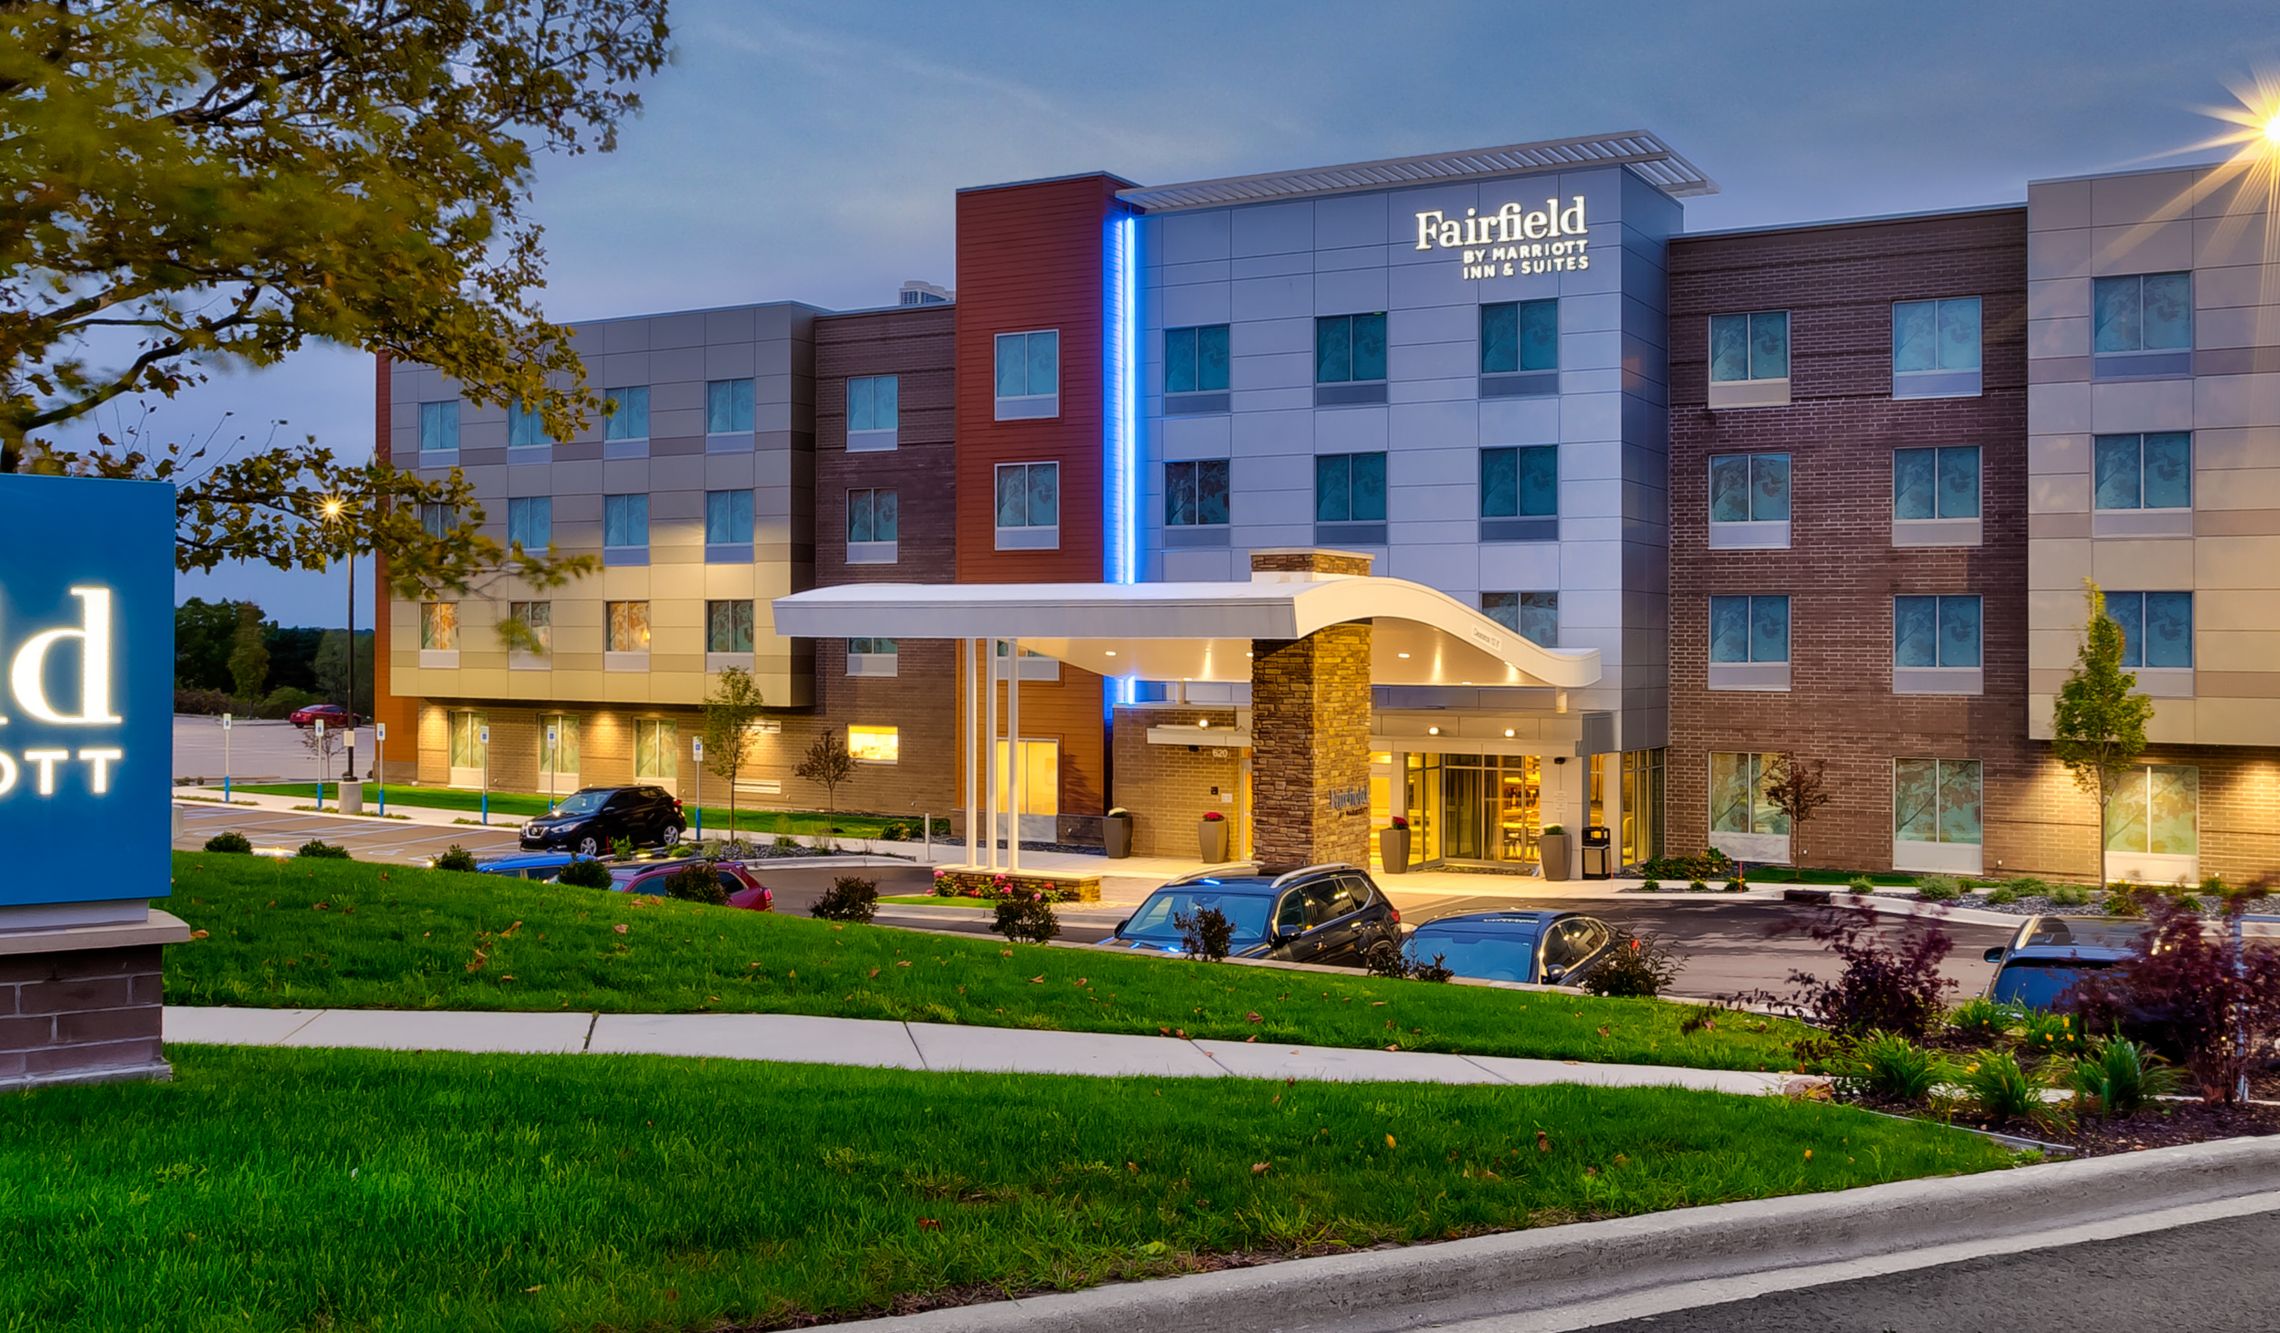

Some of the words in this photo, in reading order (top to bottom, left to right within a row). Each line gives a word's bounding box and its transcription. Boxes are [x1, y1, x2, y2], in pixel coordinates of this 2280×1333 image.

[1415, 195, 1588, 250] Fairfield
[1463, 249, 1486, 264] BY
[1492, 239, 1588, 261] MARRIOTT
[1463, 264, 1496, 280] INN
[1502, 262, 1514, 276] &
[1521, 255, 1589, 275] SUITES
[0, 586, 122, 725] d
[1212, 749, 1228, 758] 620
